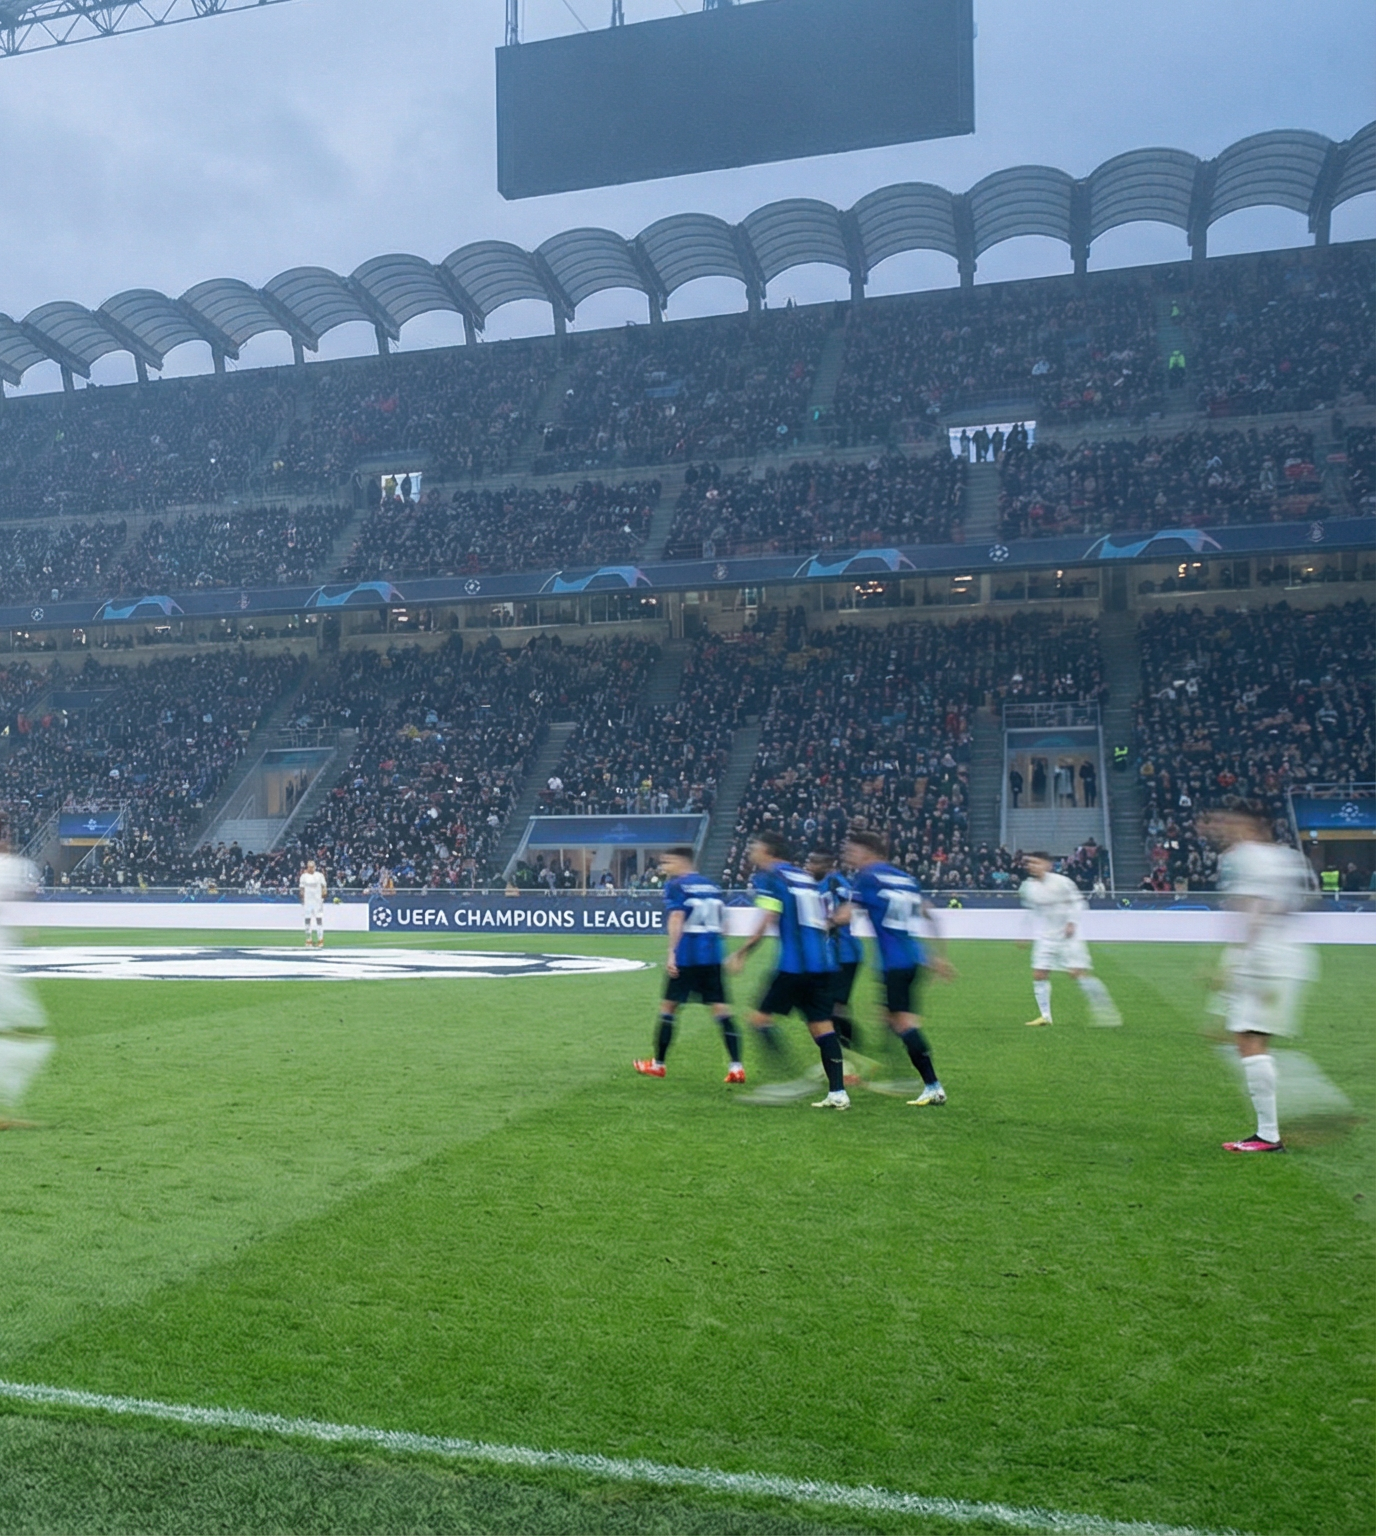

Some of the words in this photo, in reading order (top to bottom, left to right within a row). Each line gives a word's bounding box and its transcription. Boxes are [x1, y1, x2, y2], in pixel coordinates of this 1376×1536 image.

[398, 908, 449, 926] UEFA
[455, 909, 575, 928] CHAMPIONS
[583, 910, 663, 928] LEAGUE
